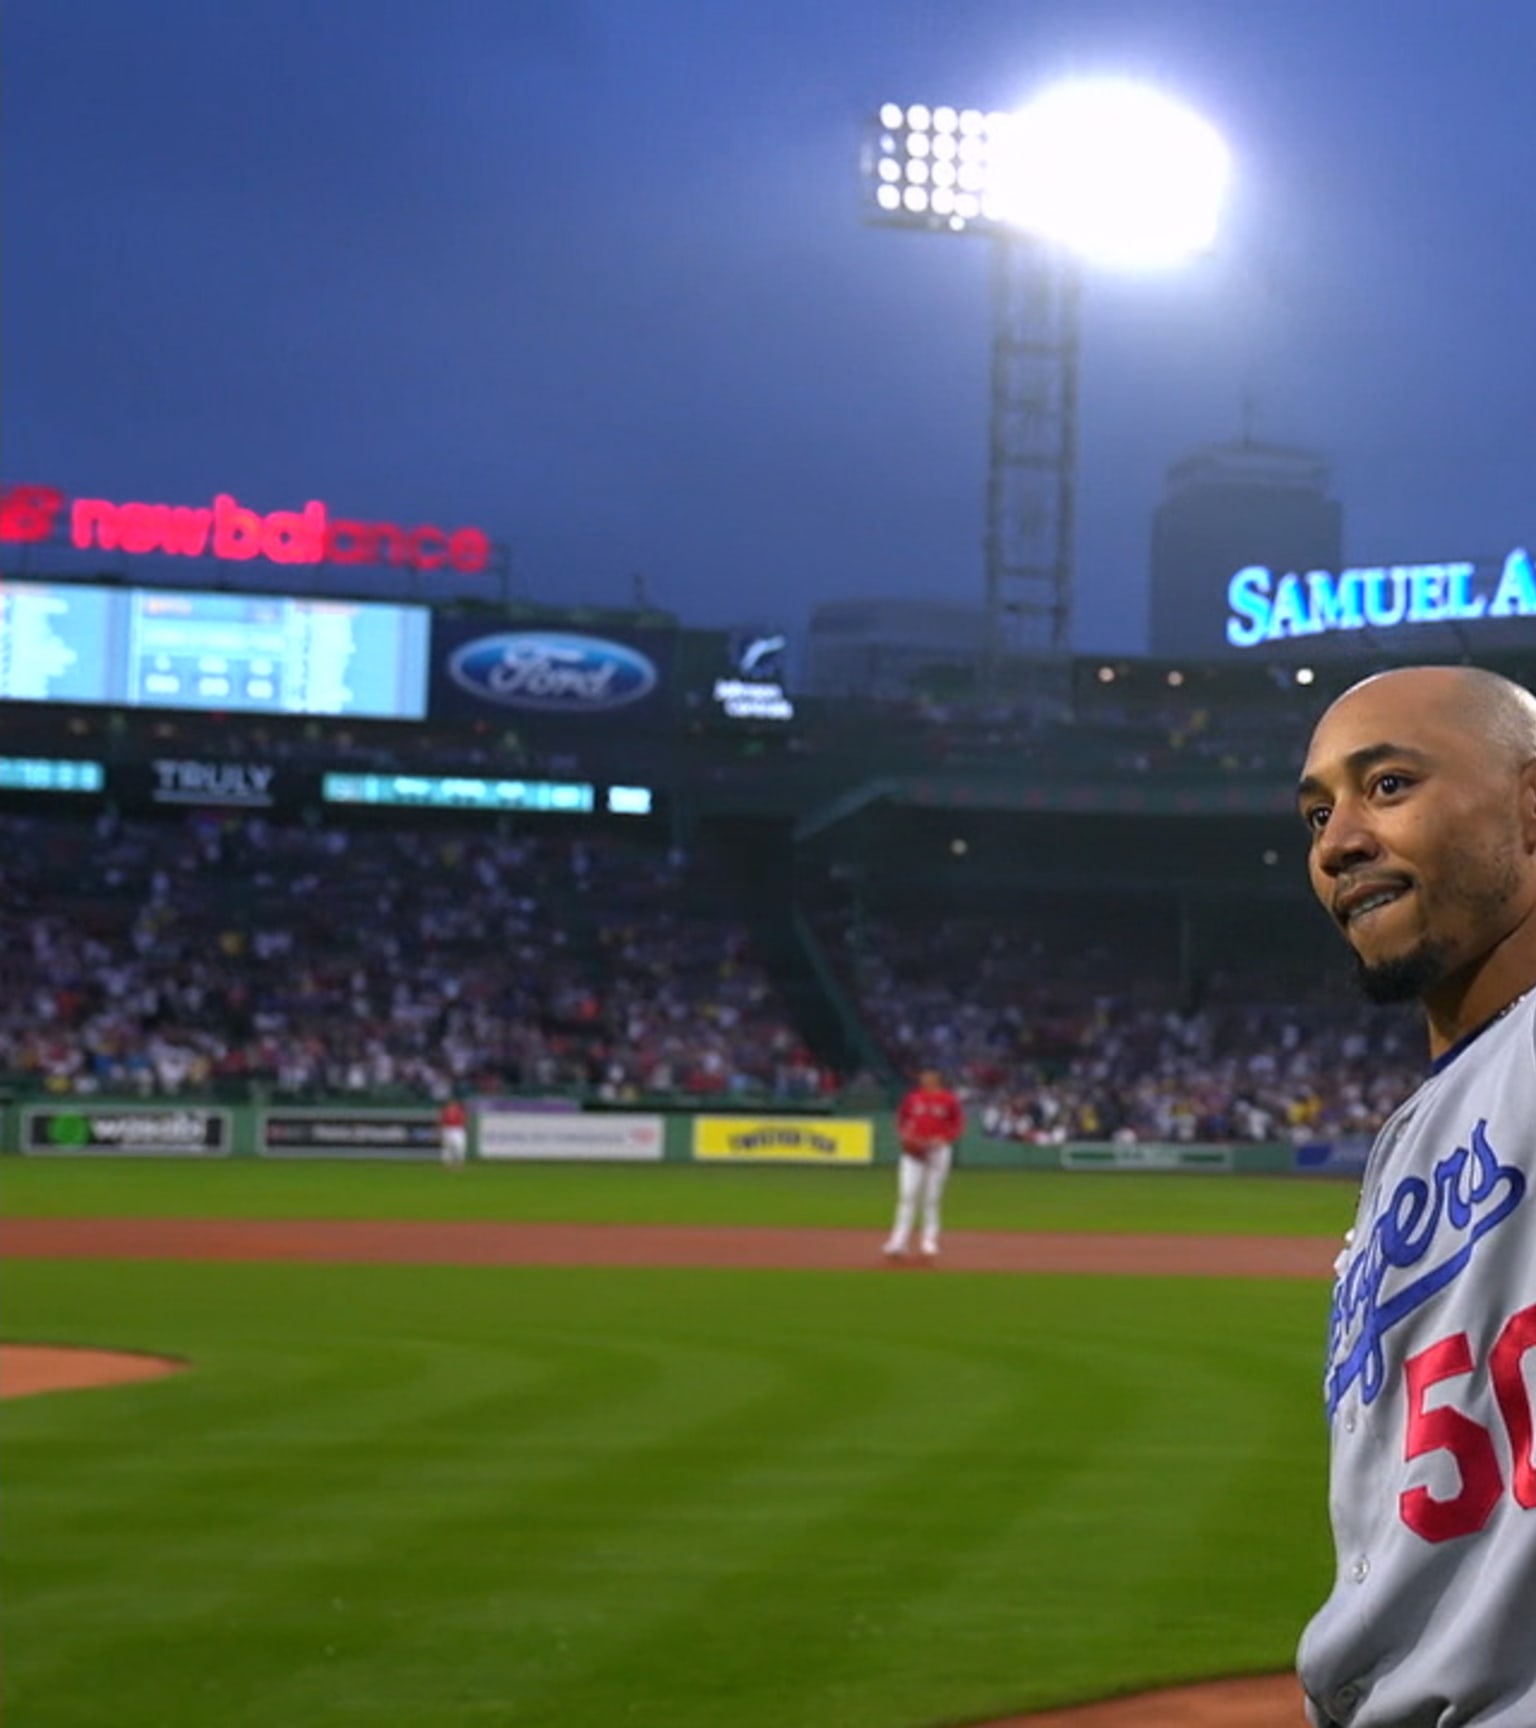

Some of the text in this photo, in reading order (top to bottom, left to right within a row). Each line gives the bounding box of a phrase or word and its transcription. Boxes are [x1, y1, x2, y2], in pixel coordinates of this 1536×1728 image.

[1226, 565, 1485, 647] SAMUEL
[489, 641, 620, 697] Ford
[151, 759, 275, 797] TRULY
[1327, 1118, 1527, 1416] gers
